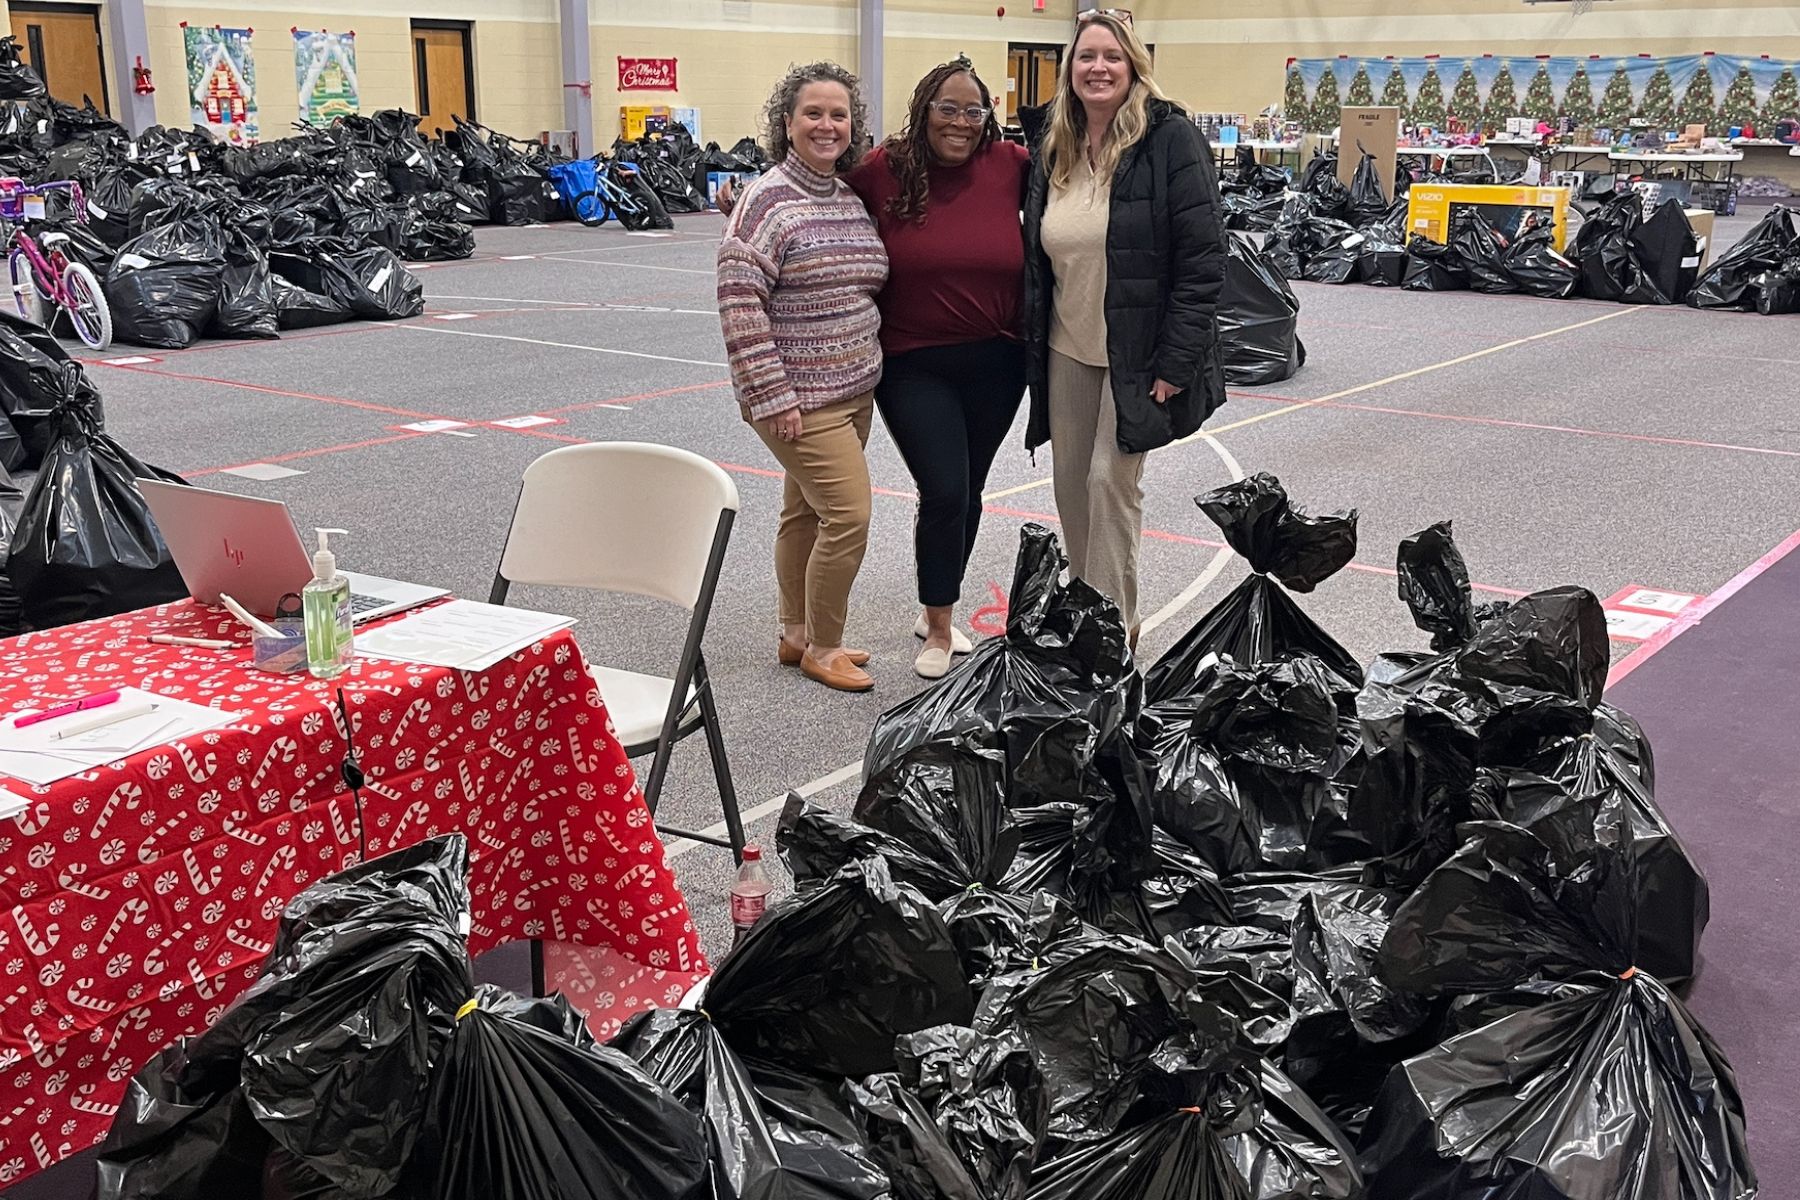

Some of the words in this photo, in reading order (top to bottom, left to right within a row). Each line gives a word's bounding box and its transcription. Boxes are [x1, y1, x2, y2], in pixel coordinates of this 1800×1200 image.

[622, 69, 673, 87] Christmas
[636, 63, 661, 78] Merry
[1416, 192, 1443, 201] VIZIO
